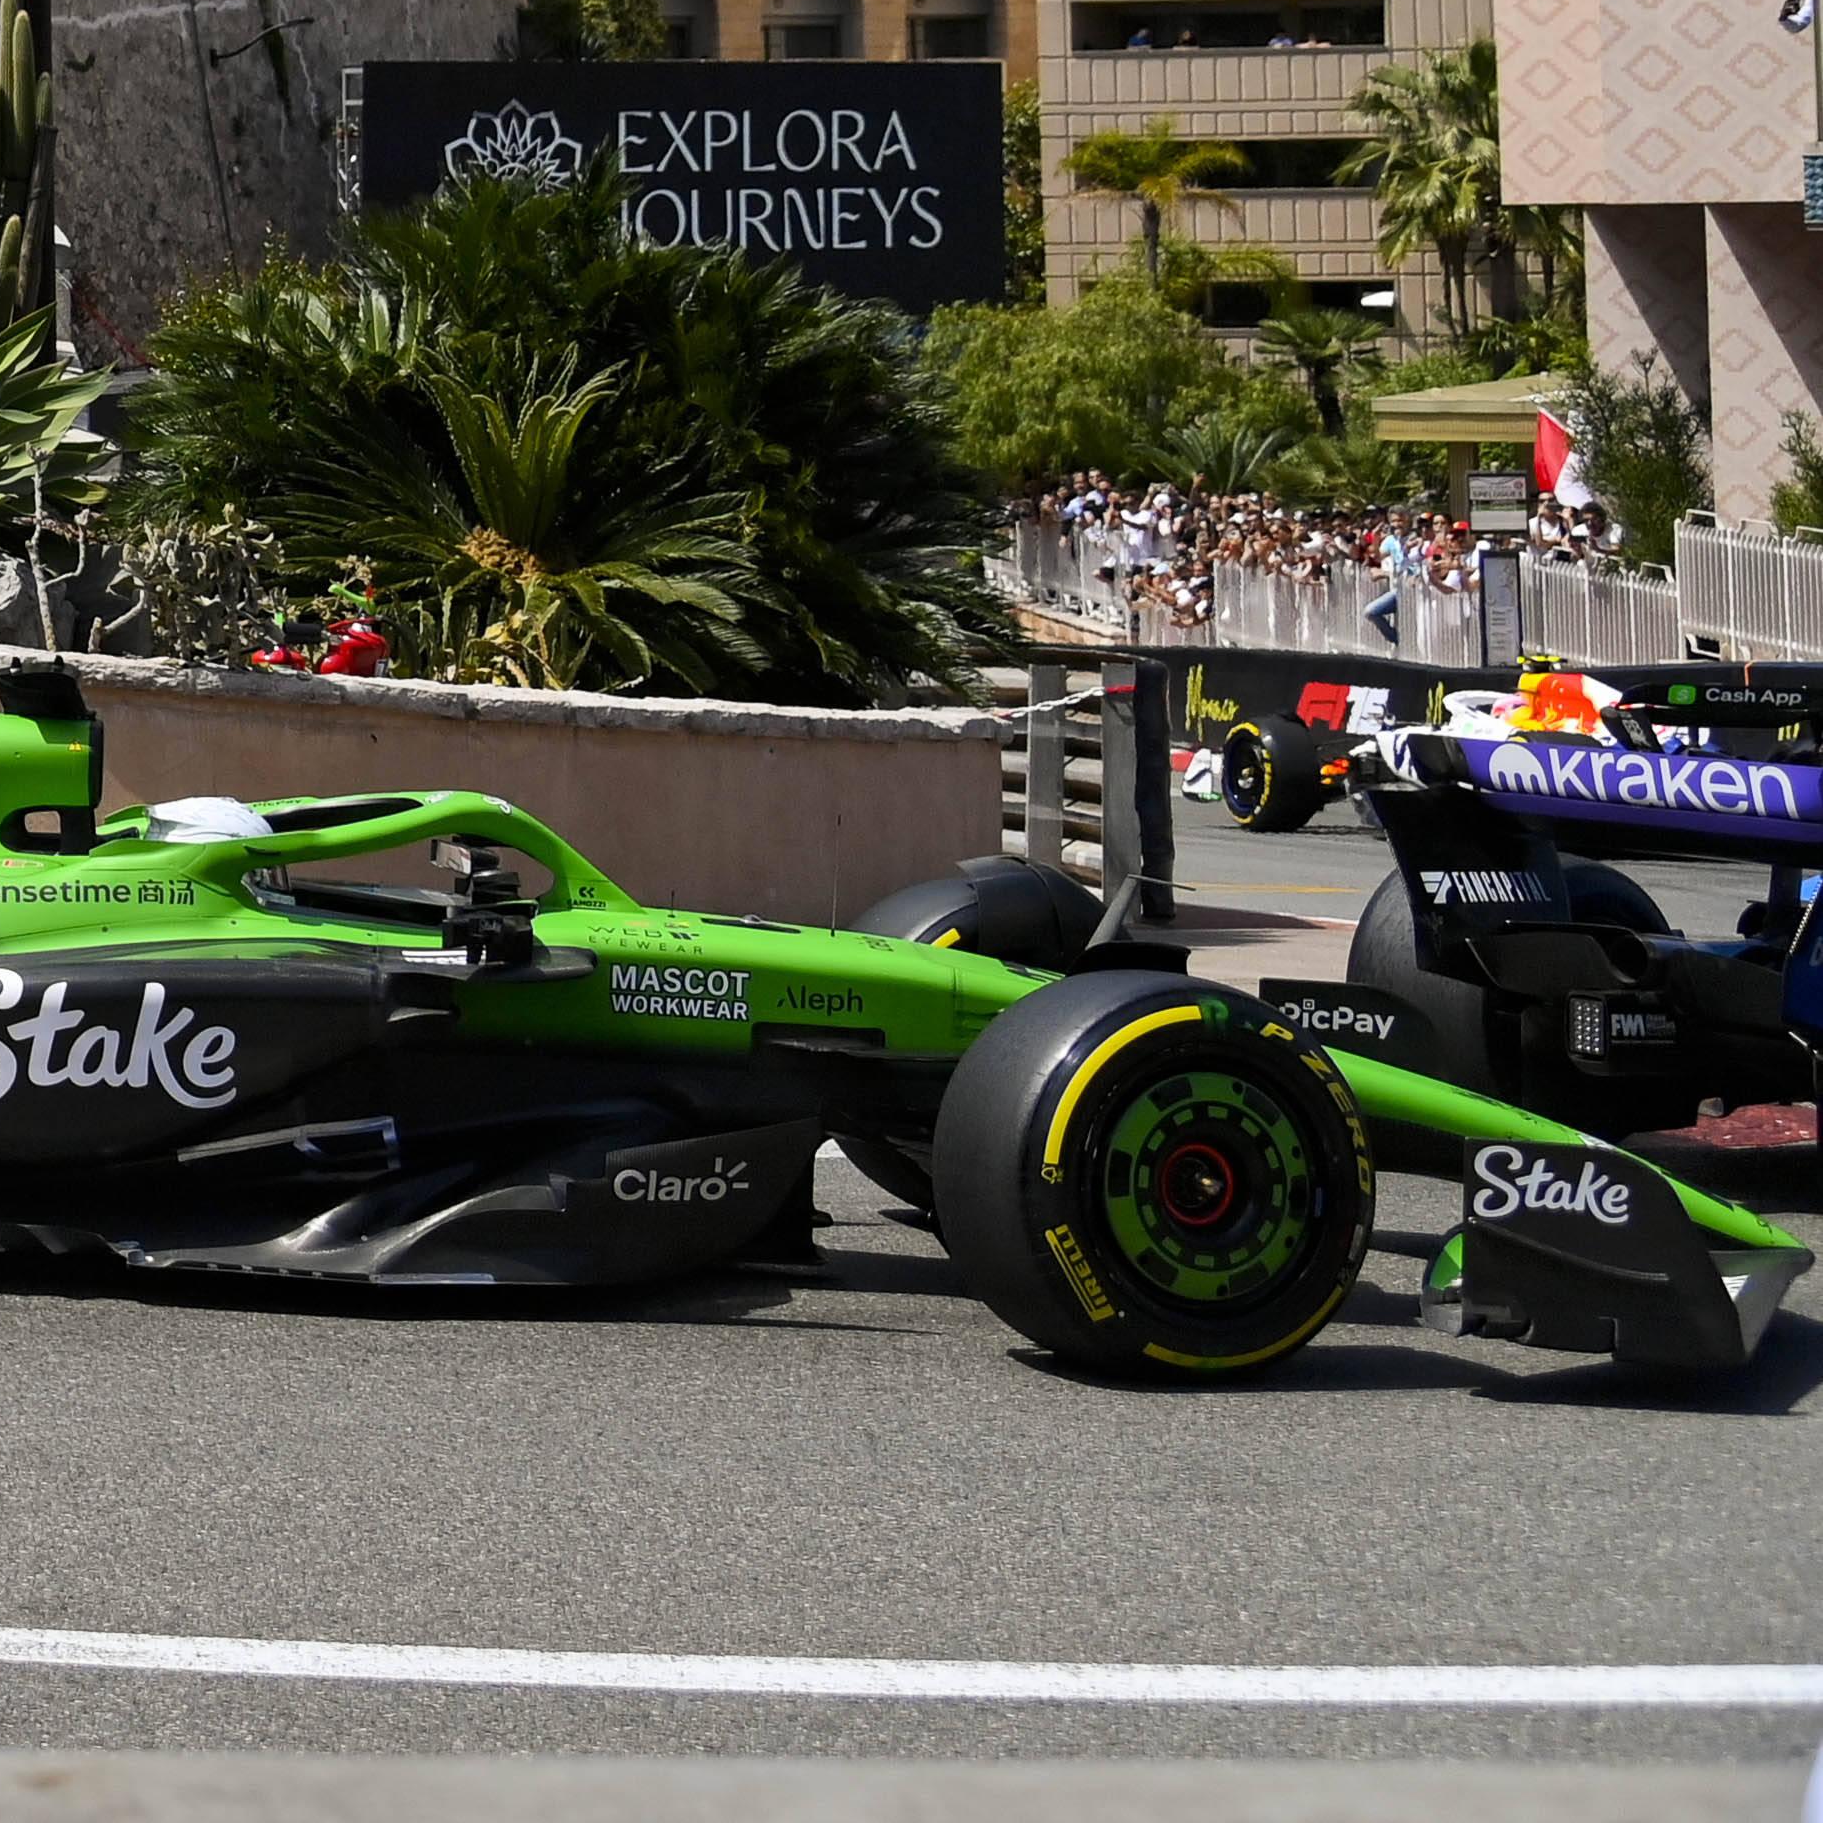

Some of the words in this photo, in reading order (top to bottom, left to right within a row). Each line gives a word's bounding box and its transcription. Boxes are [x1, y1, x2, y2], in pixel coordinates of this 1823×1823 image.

[618, 109, 917, 174] EXPLORA
[1346, 685, 1390, 736] 75
[1705, 687, 1754, 704] Cash
[1760, 688, 1803, 707] App
[1548, 745, 1801, 821] kraken
[137, 879, 195, 906] 商汤
[1451, 871, 1553, 904] FANCAPITAL
[588, 936, 703, 955] EYEWEAR
[610, 964, 750, 998] MASCOT
[611, 993, 749, 1021] WORKWEAR
[776, 985, 864, 1016] Aleph
[1279, 998, 1395, 1040] PicPay
[1299, 1049, 1372, 1196] ZERO
[613, 1168, 727, 1203] Claro
[1472, 1144, 1632, 1225] Stake
[1044, 1223, 1115, 1323] PIRELLI
